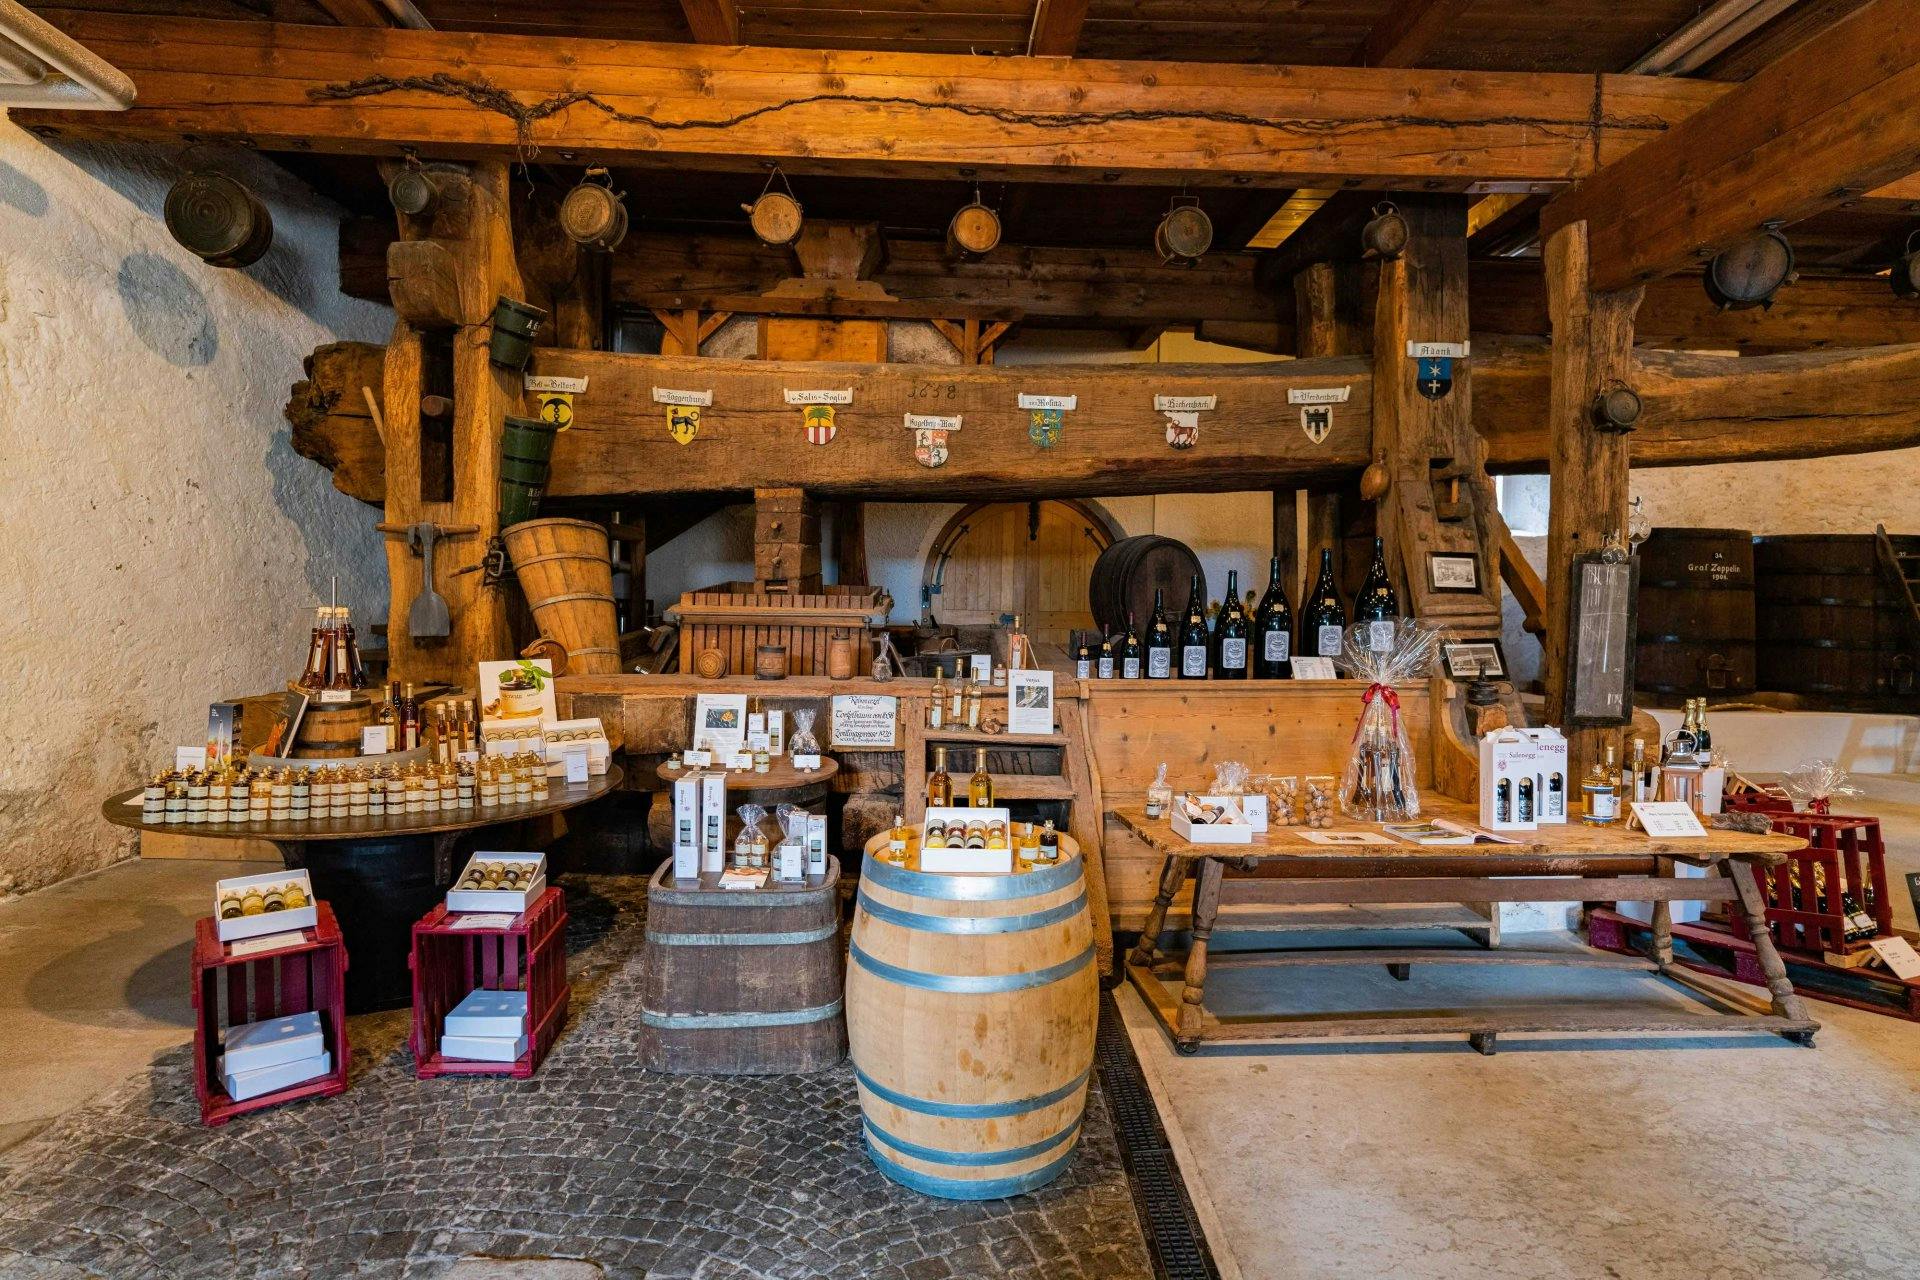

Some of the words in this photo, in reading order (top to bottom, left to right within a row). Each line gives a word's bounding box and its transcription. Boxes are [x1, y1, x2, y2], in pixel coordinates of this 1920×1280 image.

[1421, 345, 1451, 355] Adank
[907, 379, 956, 400] 1658
[667, 391, 706, 404] Toggenburg
[1687, 563, 1709, 571] Graf
[1710, 563, 1741, 574] Zeppelin
[1537, 742, 1566, 753] lenegg
[1508, 751, 1536, 760] Salenegg
